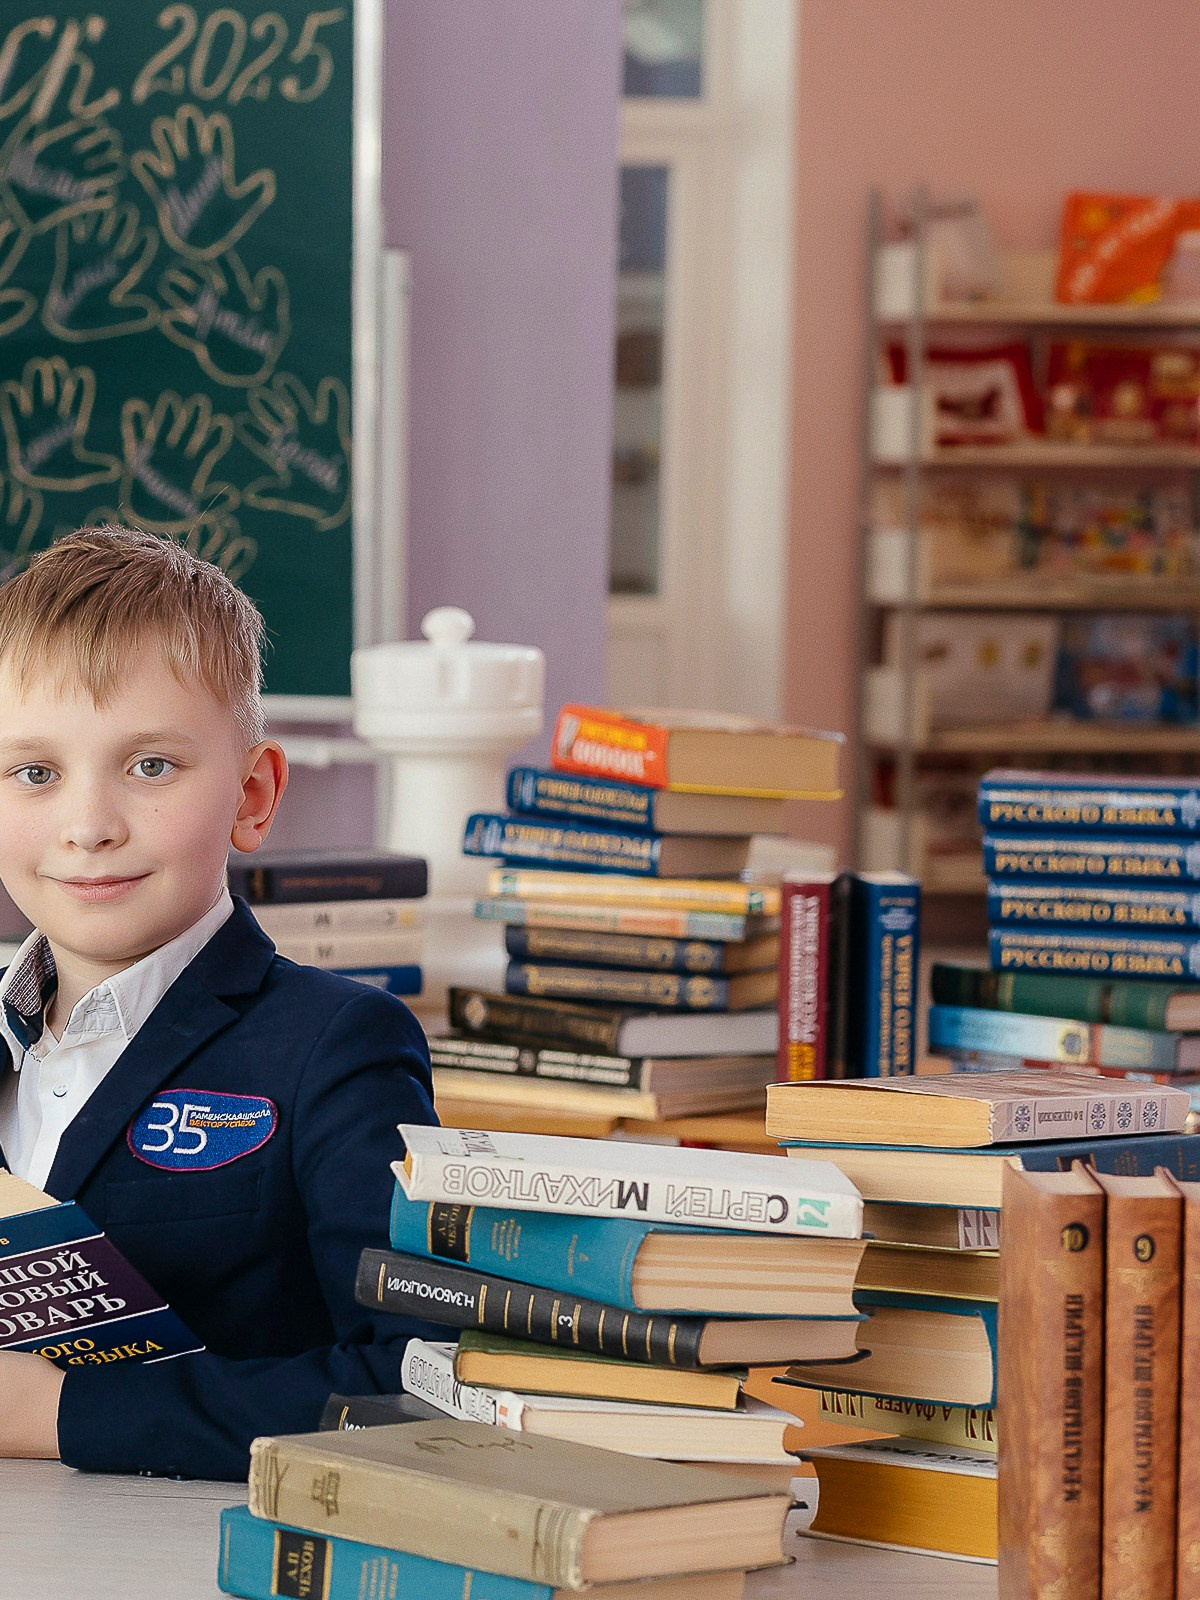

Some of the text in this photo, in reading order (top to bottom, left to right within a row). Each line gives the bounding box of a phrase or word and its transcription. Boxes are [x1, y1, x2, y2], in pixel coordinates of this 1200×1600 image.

[131, 3, 345, 106] 2025
[142, 1102, 211, 1155] 35
[442, 1163, 790, 1225] СЕРГЕЙ МИХАЛКОВ
[32, 1338, 96, 1361] ОГО
[299, 1540, 316, 1598] ЧЕХОВ
